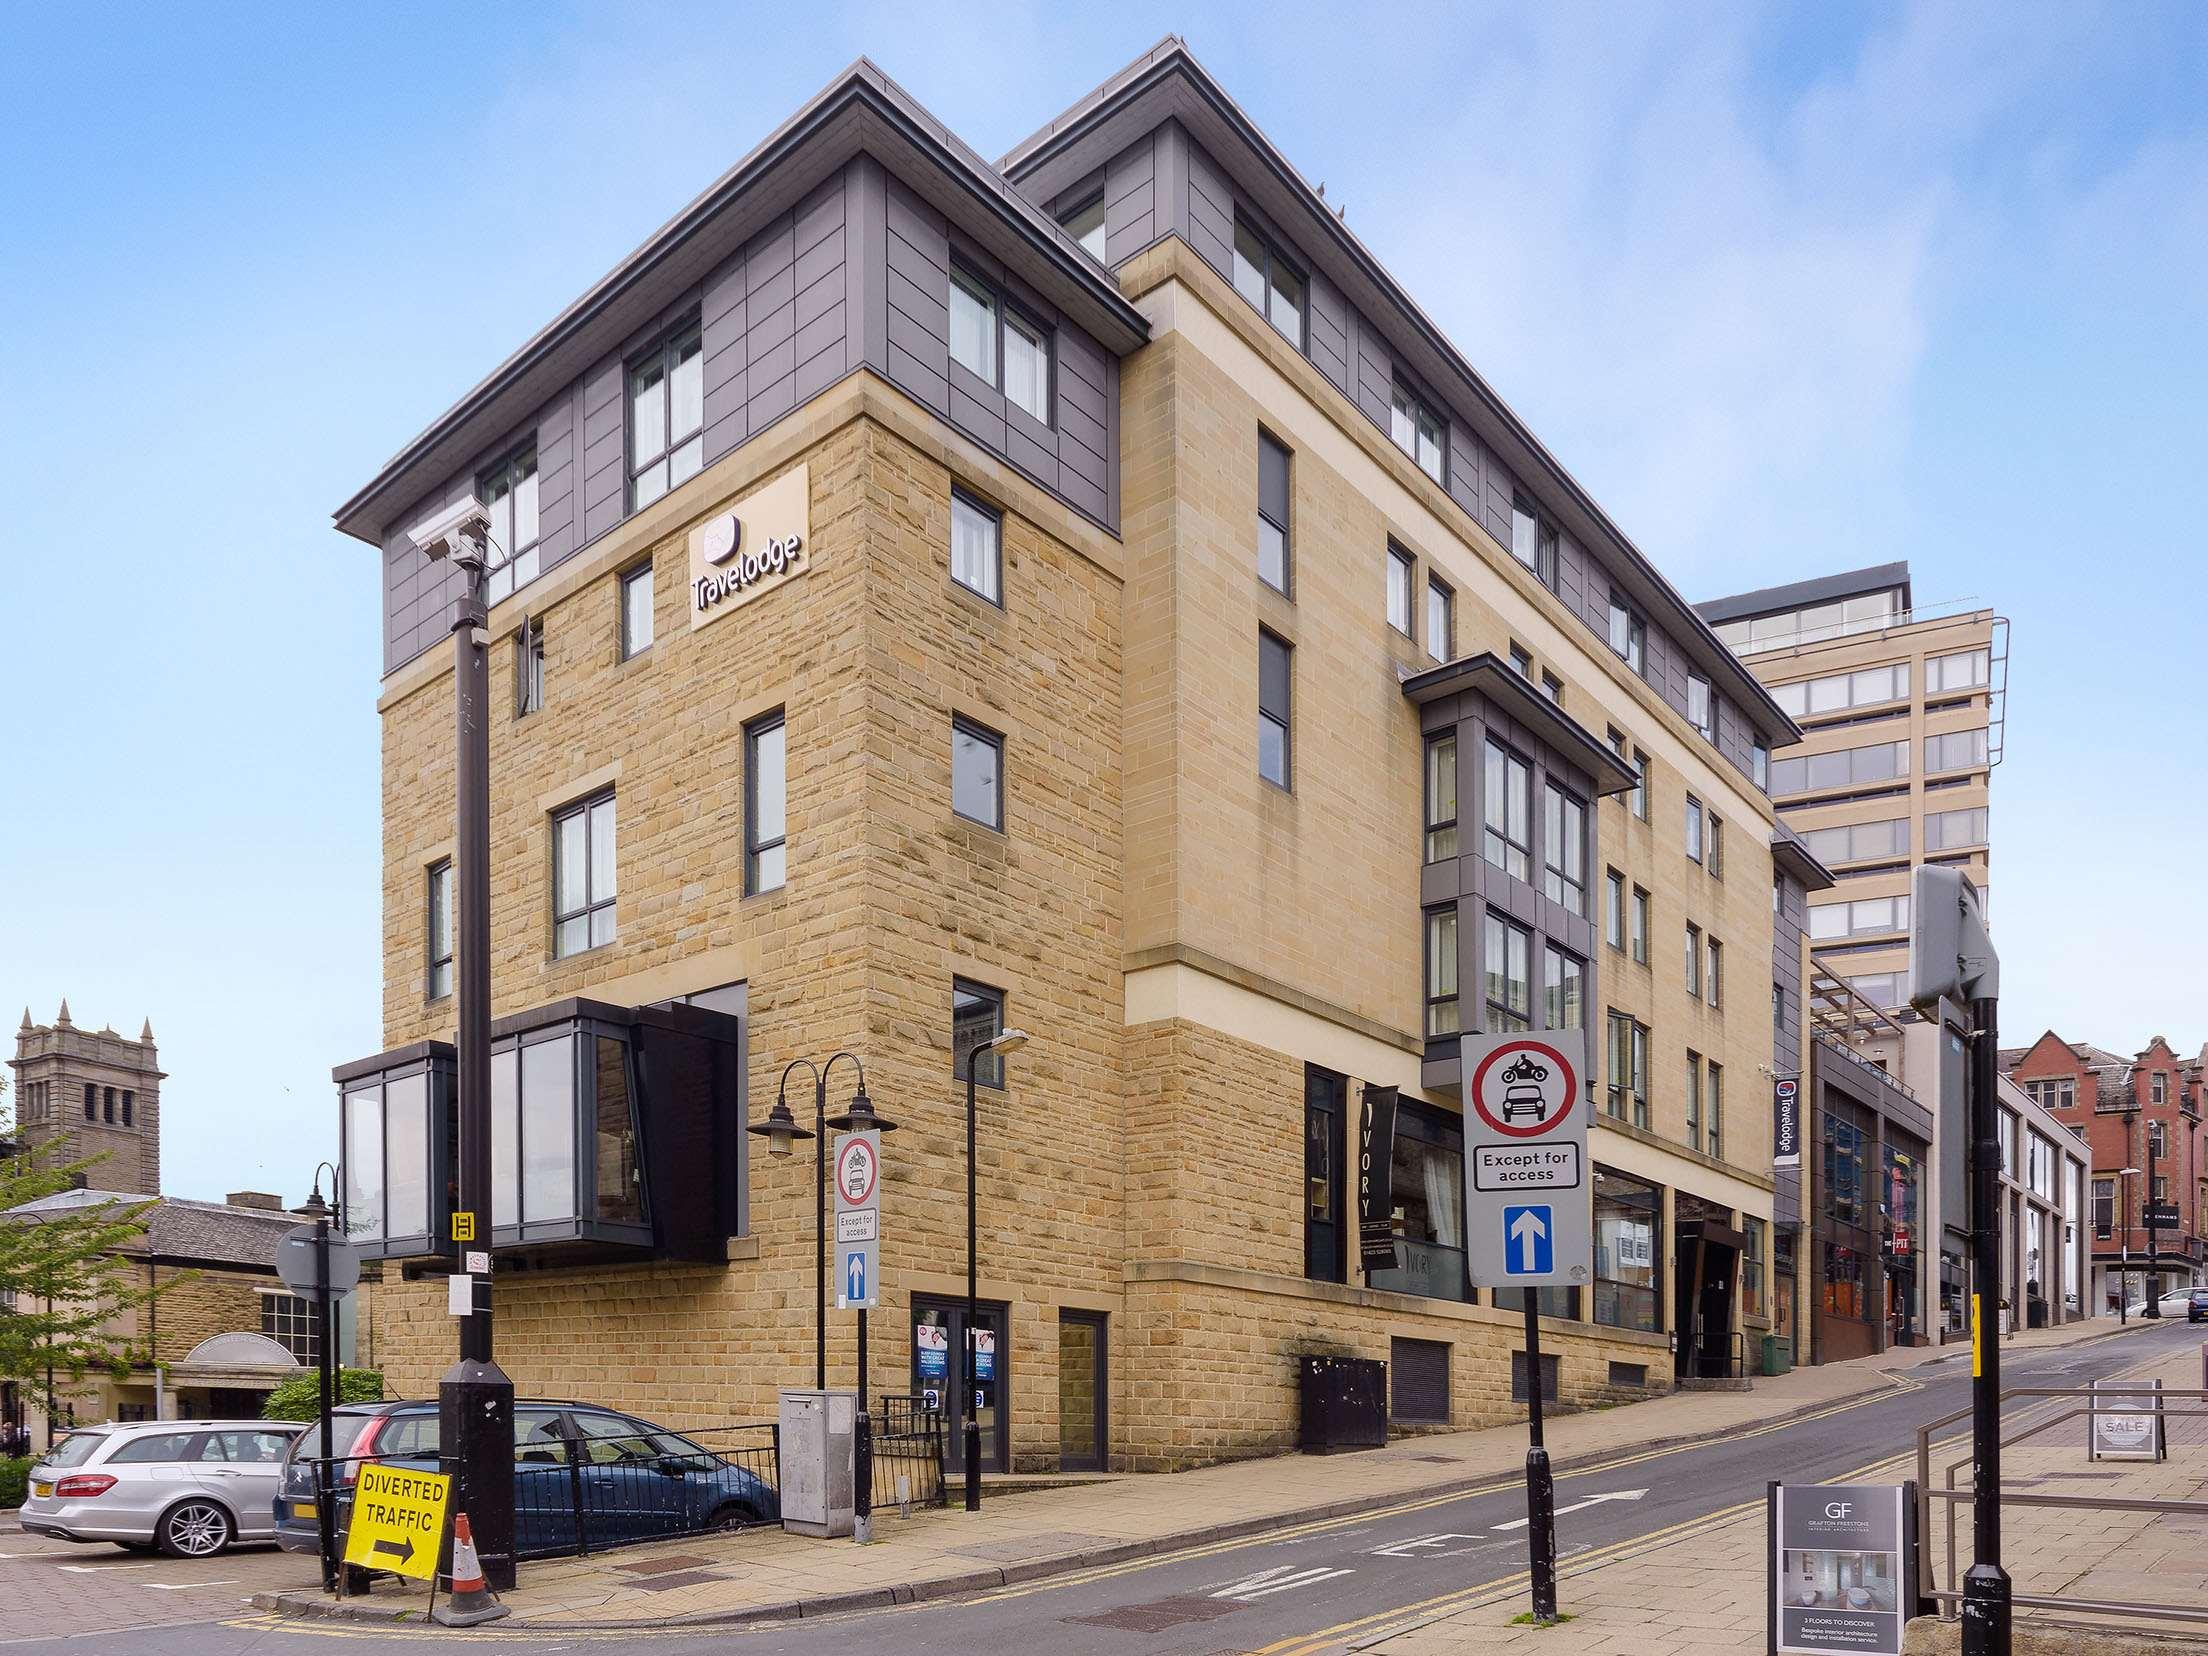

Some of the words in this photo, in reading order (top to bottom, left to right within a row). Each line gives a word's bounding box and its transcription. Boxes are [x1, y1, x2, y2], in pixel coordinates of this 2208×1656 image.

[691, 534, 800, 610] Travelodge
[1781, 1097, 1794, 1152] Travelodge
[1362, 1103, 1373, 1217] IVORY
[1484, 1152, 1540, 1168] Except
[1545, 1152, 1568, 1165] for
[1500, 1169, 1554, 1182] access
[456, 1215, 470, 1238] H
[841, 1216, 862, 1227] Except
[863, 1214, 873, 1224] for
[846, 1228, 867, 1237] access
[1896, 1238, 1908, 1249] PIT
[2105, 1422, 2144, 1432] SALE
[364, 1472, 443, 1502] DIVERTED
[367, 1503, 432, 1532] TRAFFIC
[1825, 1502, 1852, 1519] GF
